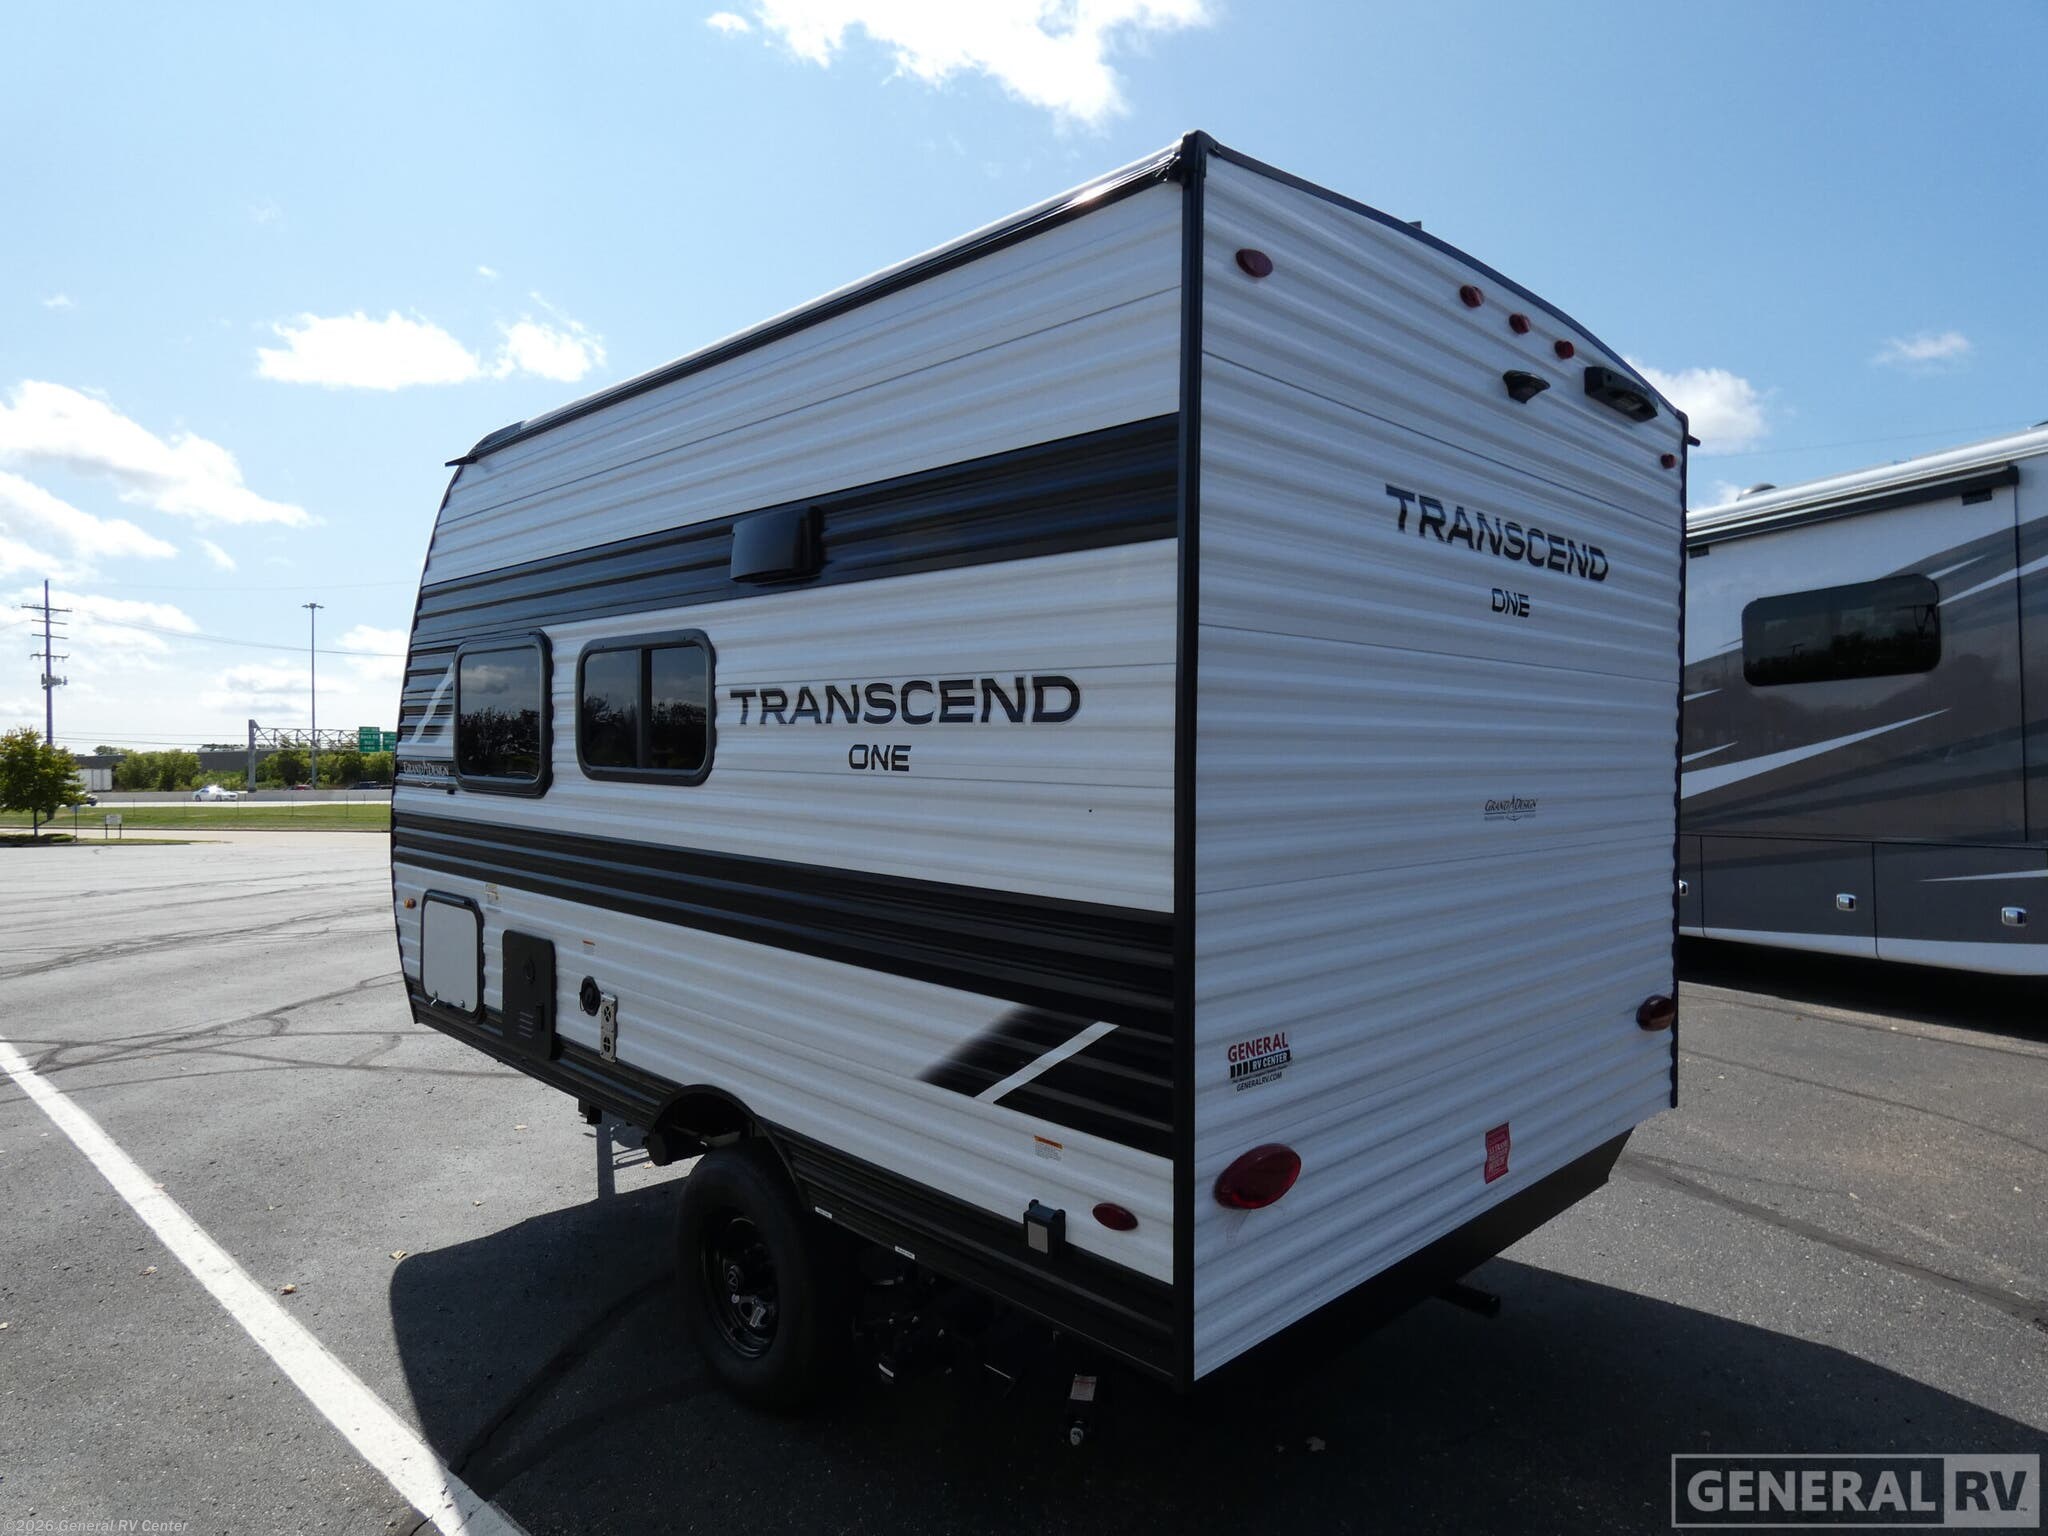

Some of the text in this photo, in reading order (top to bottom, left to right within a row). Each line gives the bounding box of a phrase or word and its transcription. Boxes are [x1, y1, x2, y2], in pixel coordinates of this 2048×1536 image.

[1385, 482, 1609, 582] TRANSCEND
[1491, 587, 1530, 618] ONE
[729, 674, 1082, 726] TRANSCEND
[848, 743, 912, 772] ONE
[1228, 1032, 1289, 1063] GENERAL
[1252, 1052, 1288, 1071] RV CENTER
[1236, 1071, 1283, 1092] GENERALRV.COM
